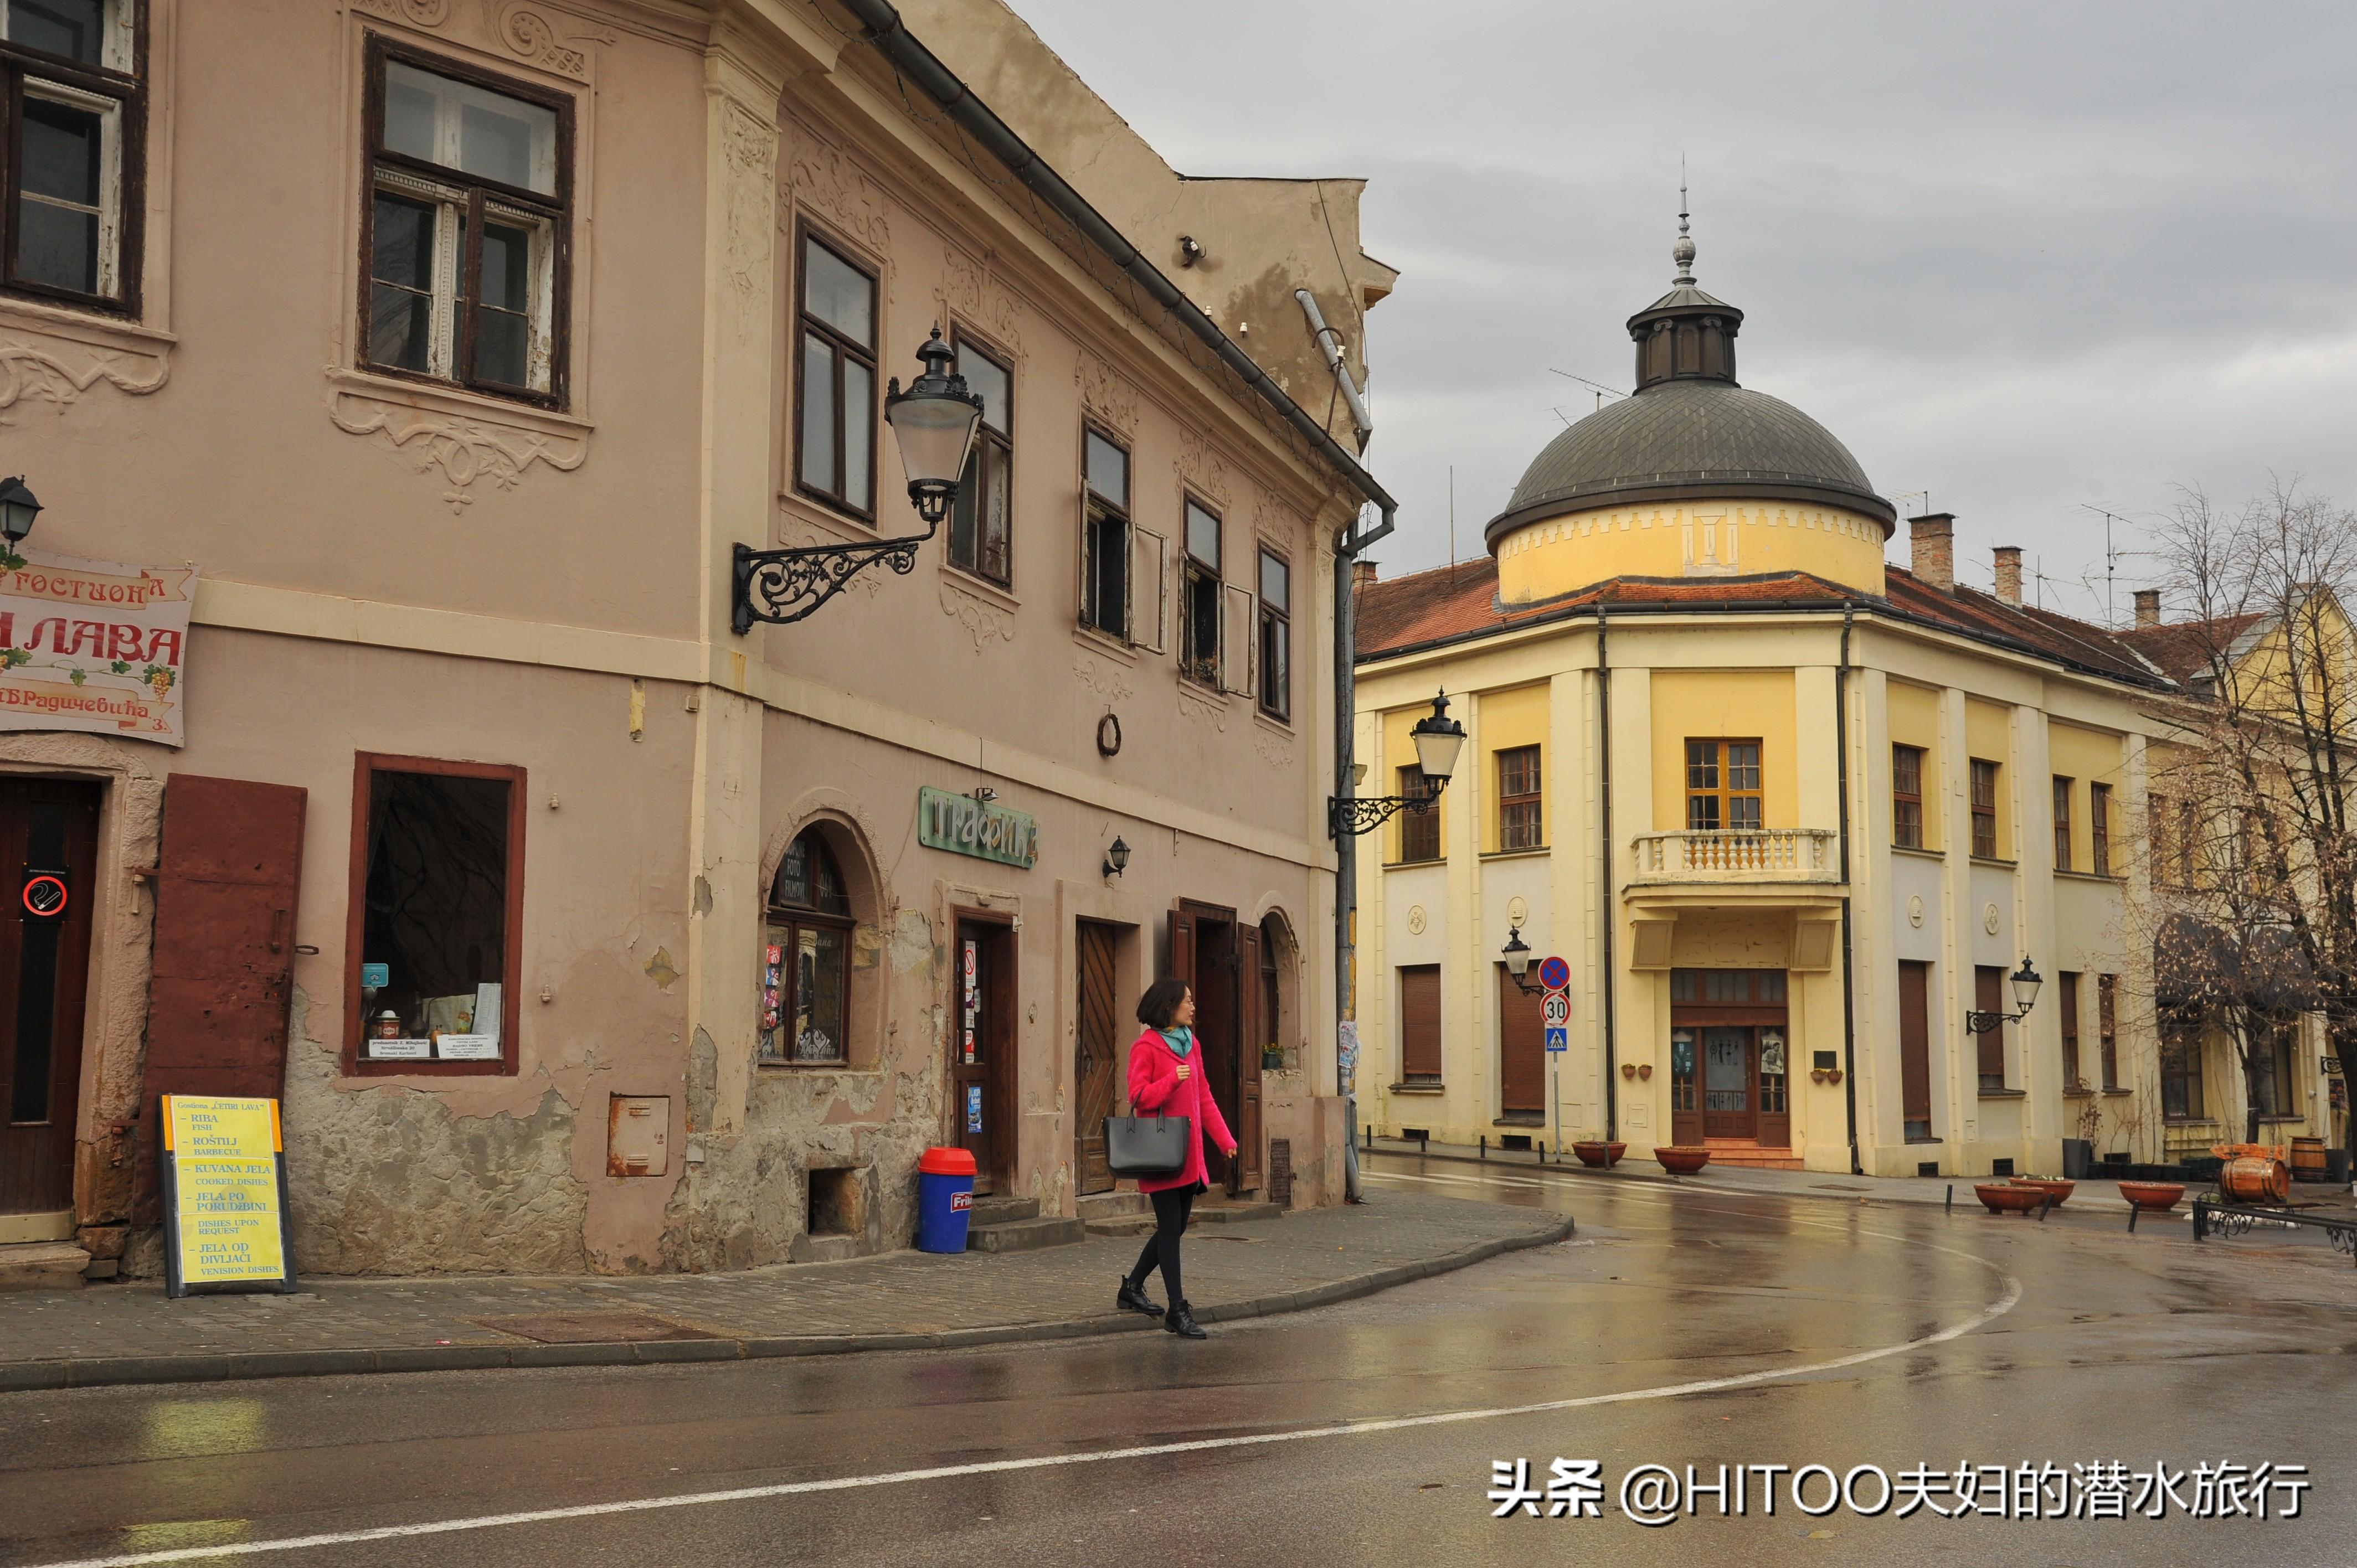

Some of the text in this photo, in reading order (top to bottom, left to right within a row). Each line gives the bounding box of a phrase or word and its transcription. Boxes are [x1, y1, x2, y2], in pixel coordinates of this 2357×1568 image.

[14, 570, 166, 604] ГОСТИОНА
[24, 617, 182, 666] ЛАВА
[787, 858, 801, 877] FOTO
[785, 879, 805, 899] FILMOVI
[1547, 1002, 1565, 1019] 30
[191, 1114, 218, 1123] RIBA
[193, 1134, 238, 1146] ROŠTILJ
[195, 1164, 271, 1174] KUVANA JELA
[196, 1192, 244, 1201] JELA PO
[199, 1242, 249, 1253] JELA OD
[200, 1252, 251, 1264] DIVLJAČI
[200, 1267, 244, 1275] VENISION
